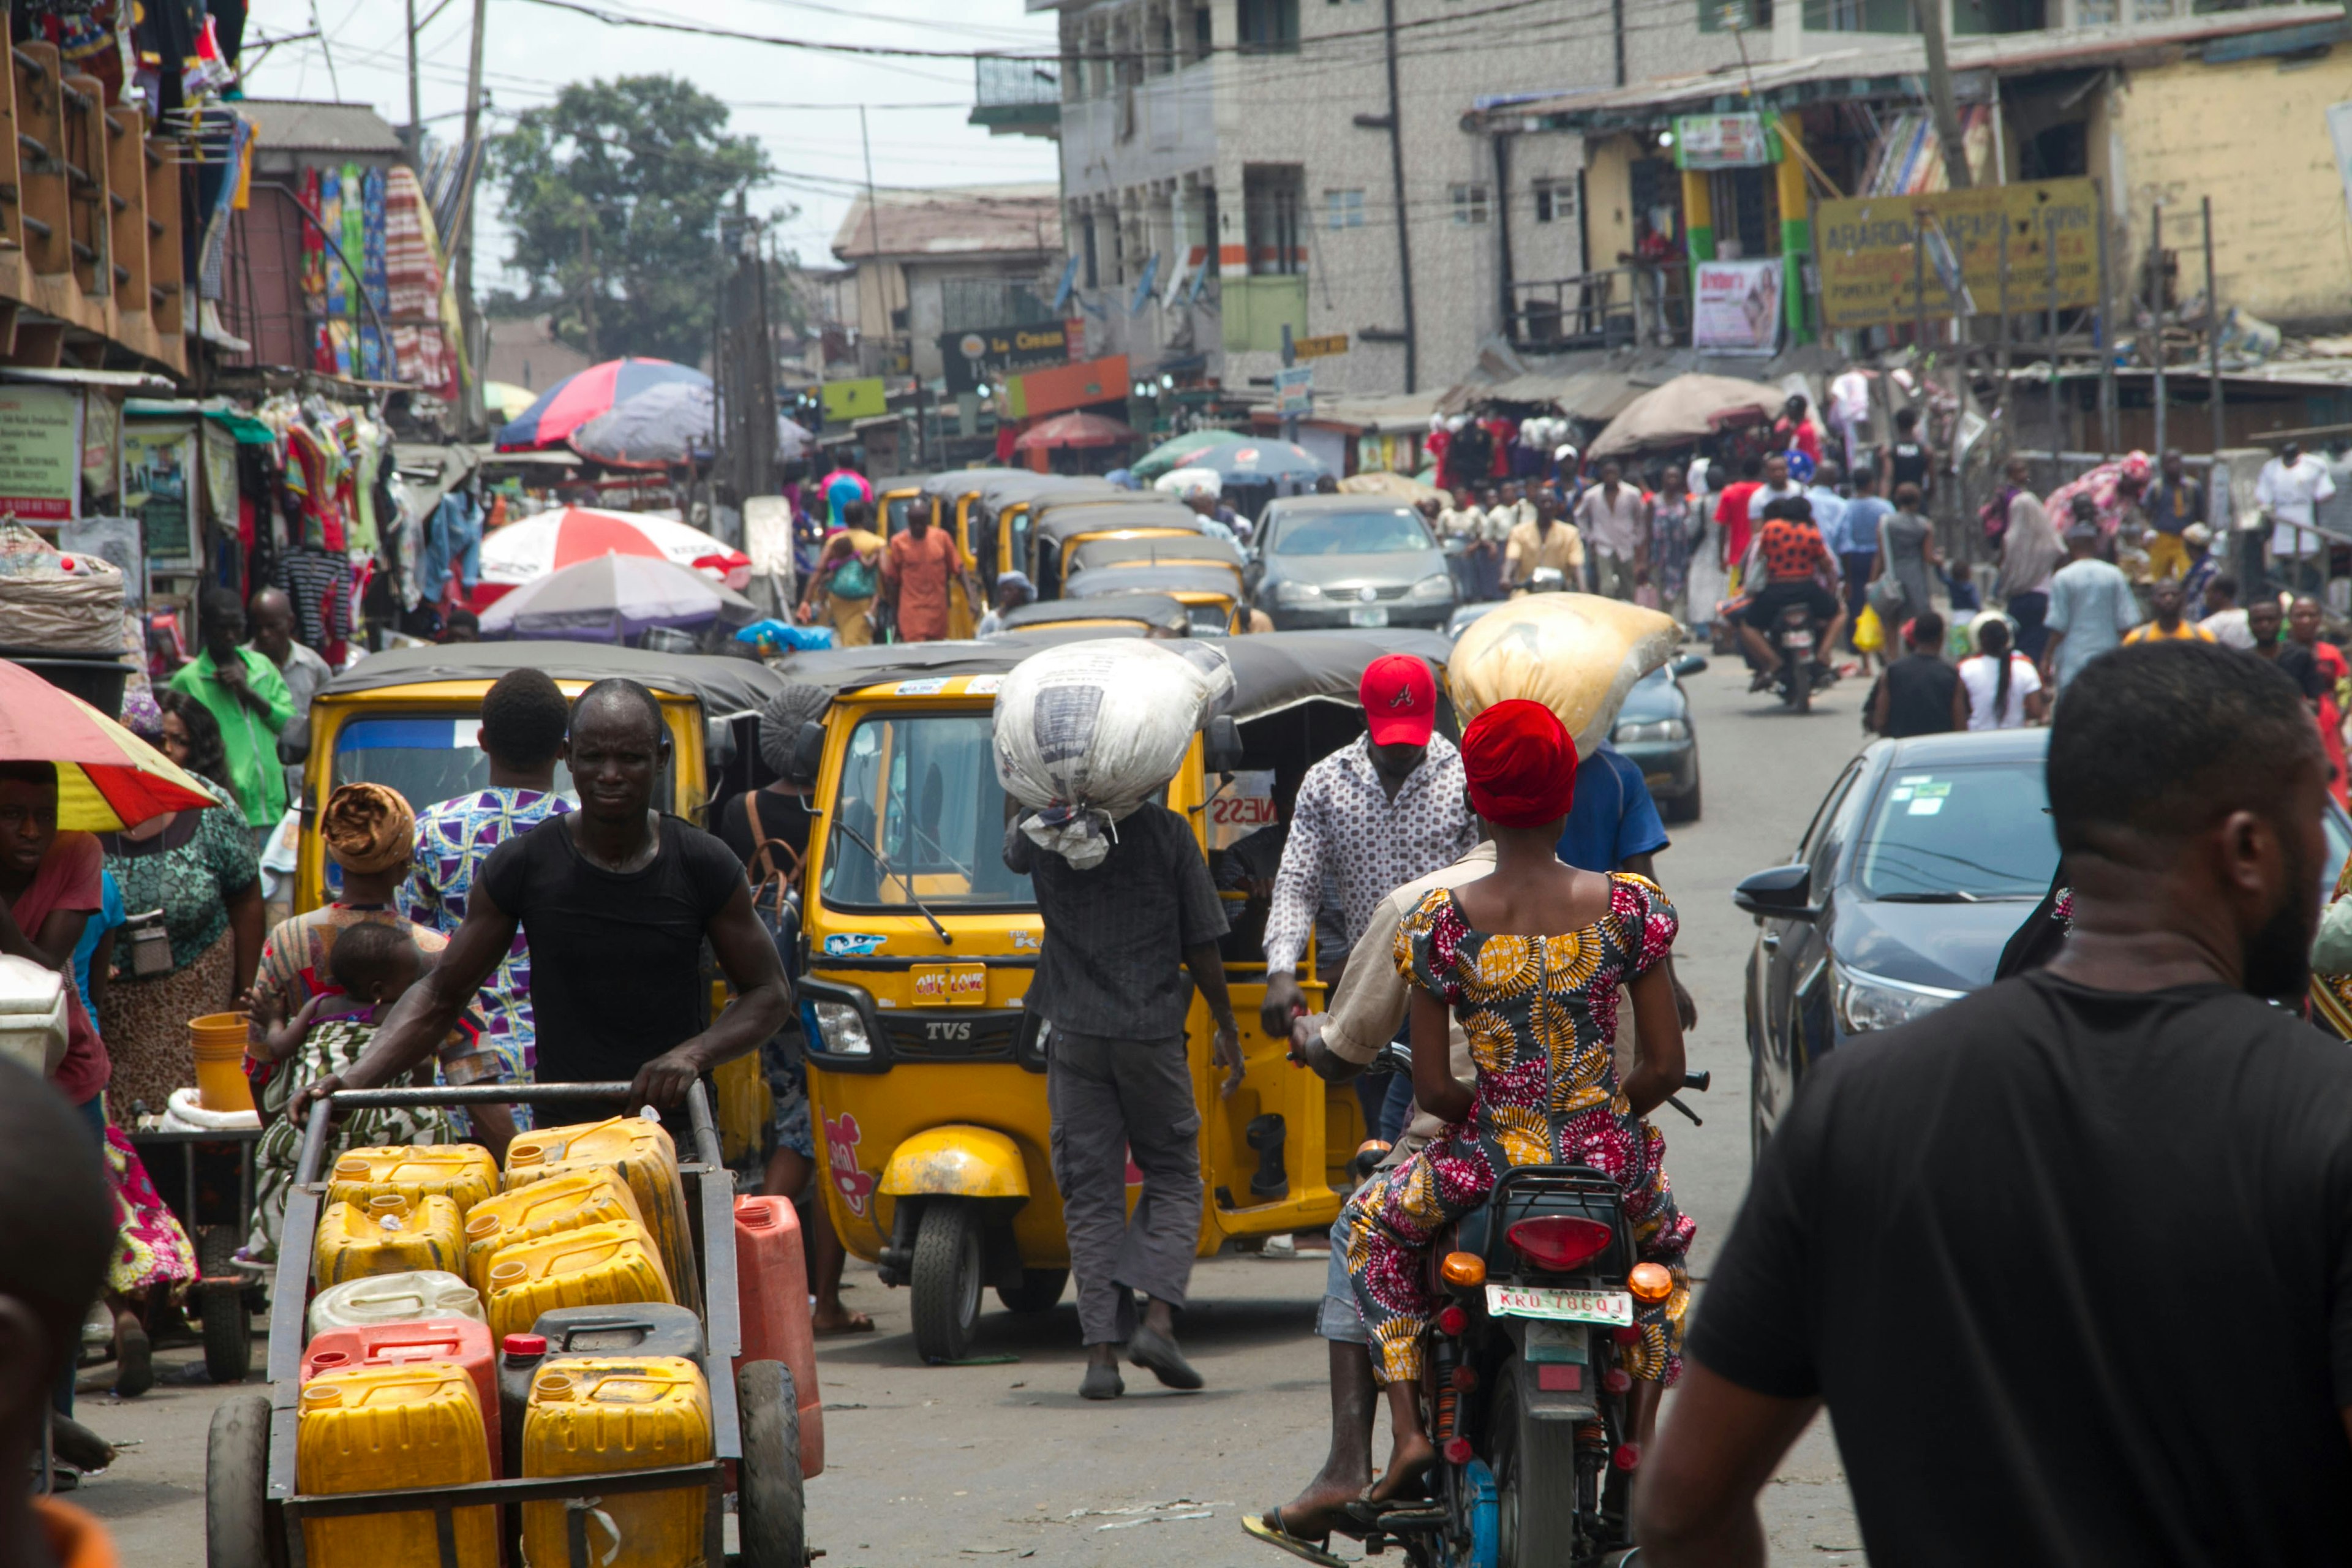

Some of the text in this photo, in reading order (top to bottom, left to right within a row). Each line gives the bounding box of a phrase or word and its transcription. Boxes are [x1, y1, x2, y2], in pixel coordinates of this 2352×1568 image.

[916, 972, 984, 995] ONE LOVE
[926, 1022, 971, 1040] TVS
